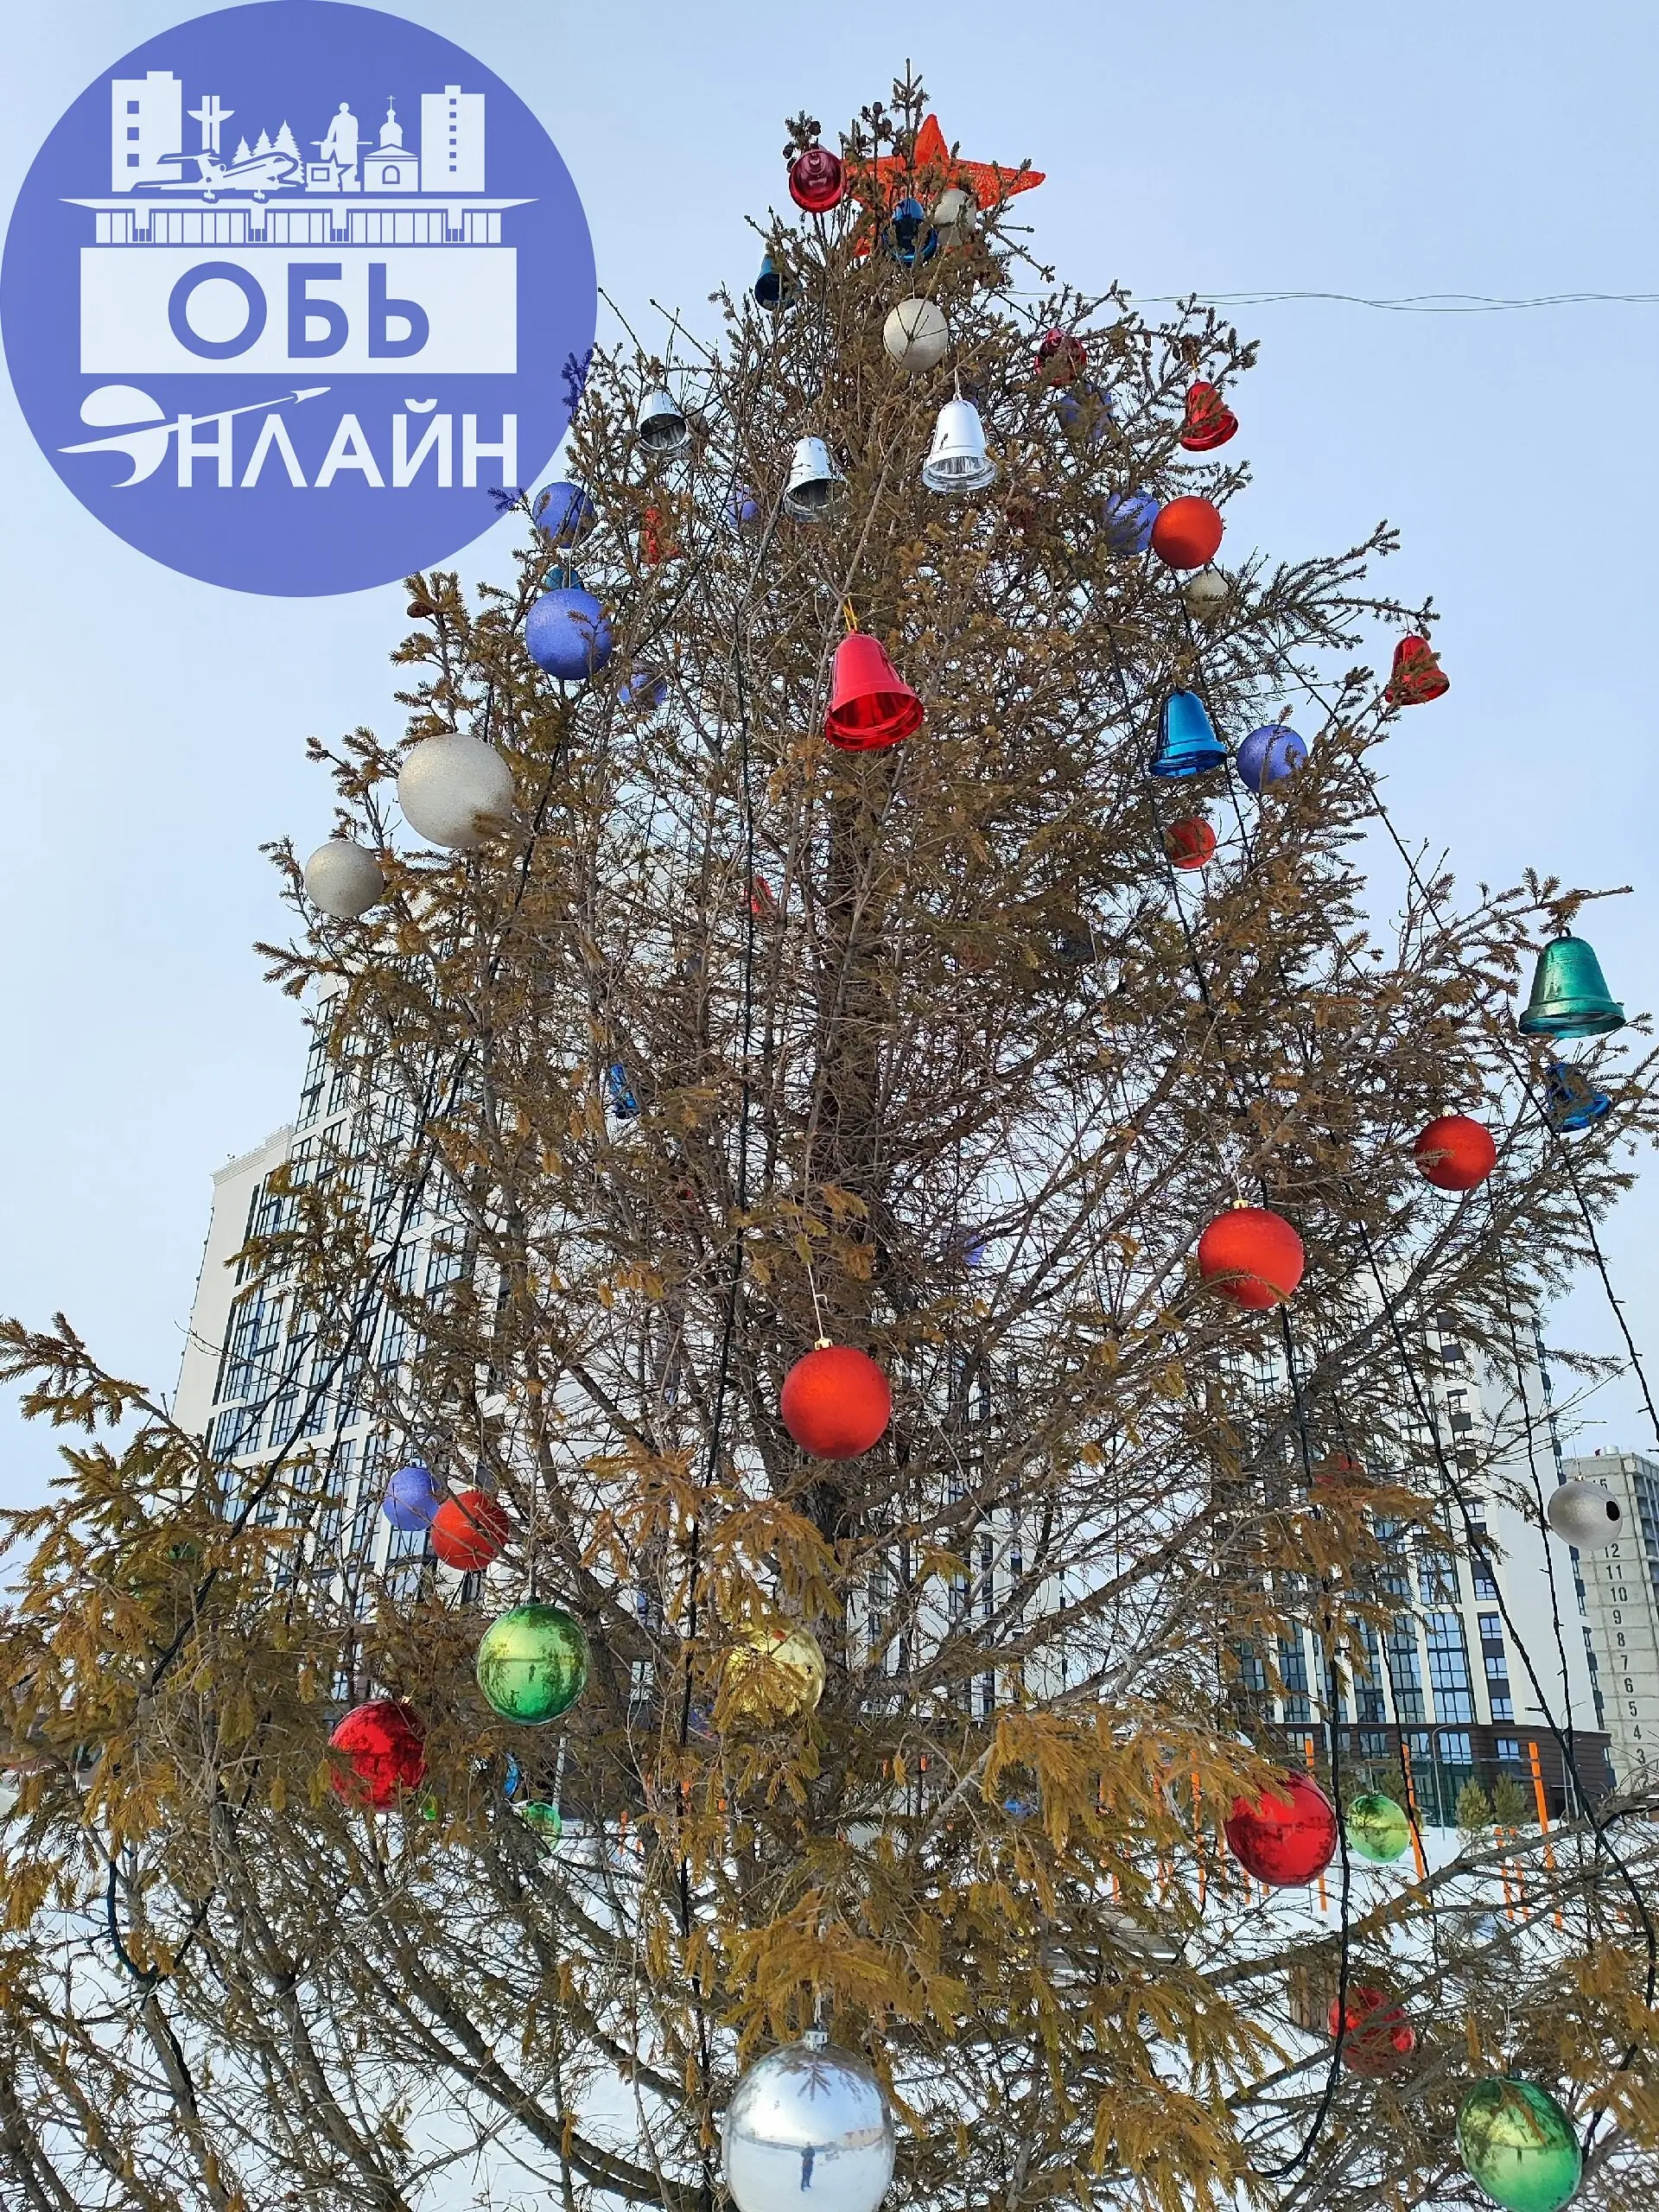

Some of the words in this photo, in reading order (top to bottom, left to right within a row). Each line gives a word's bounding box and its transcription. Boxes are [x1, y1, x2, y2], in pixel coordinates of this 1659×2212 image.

[1592, 1478, 1608, 1491] 5
[1605, 1542, 1621, 1558] 12
[1605, 1564, 1623, 1580] 11
[1610, 1586, 1628, 1602] 10
[1612, 1609, 1622, 1624] 9
[1617, 1631, 1626, 1647] 8
[1620, 1655, 1628, 1671] 7
[1624, 1677, 1634, 1694] 6
[1628, 1700, 1637, 1717] 5
[1633, 1724, 1642, 1740] 4
[1636, 1748, 1646, 1764] 3
